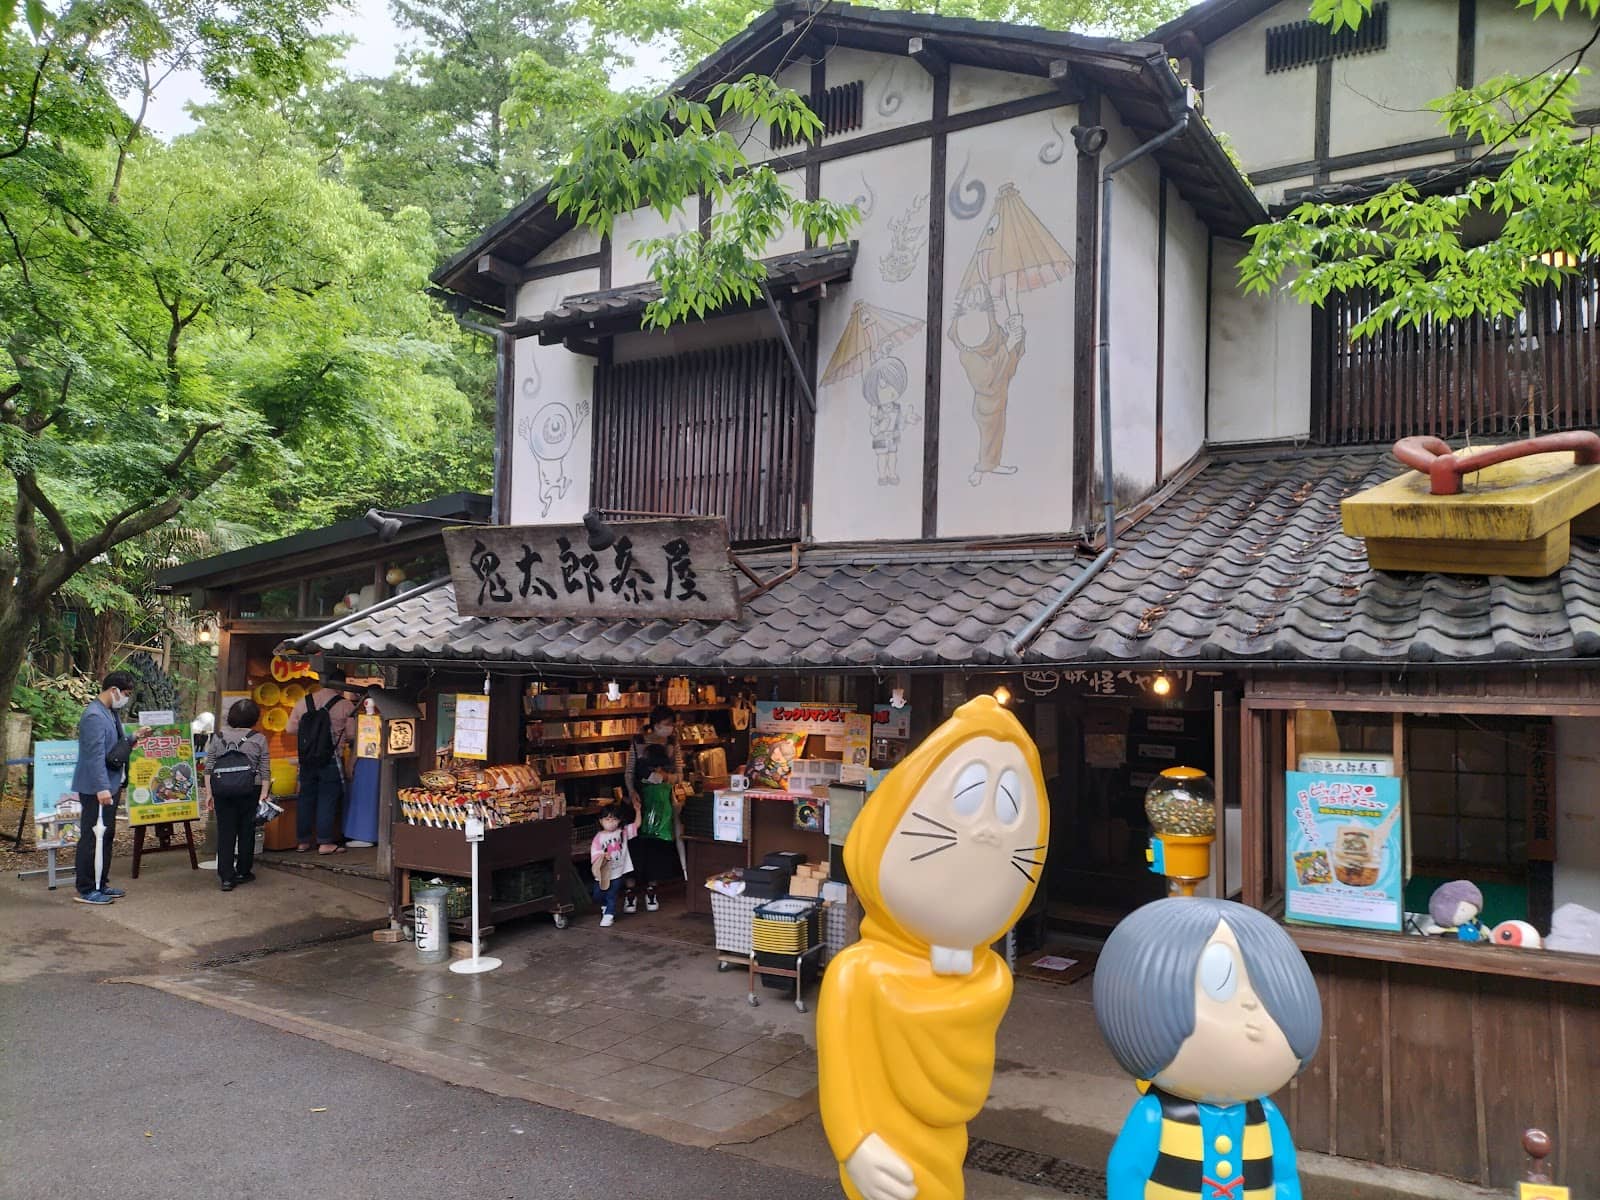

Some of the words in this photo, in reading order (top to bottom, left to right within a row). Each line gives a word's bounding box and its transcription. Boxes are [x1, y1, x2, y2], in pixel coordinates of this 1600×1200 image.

[470, 536, 707, 606] 鬼太郎茶屋
[773, 706, 845, 722] ビックリマンビ
